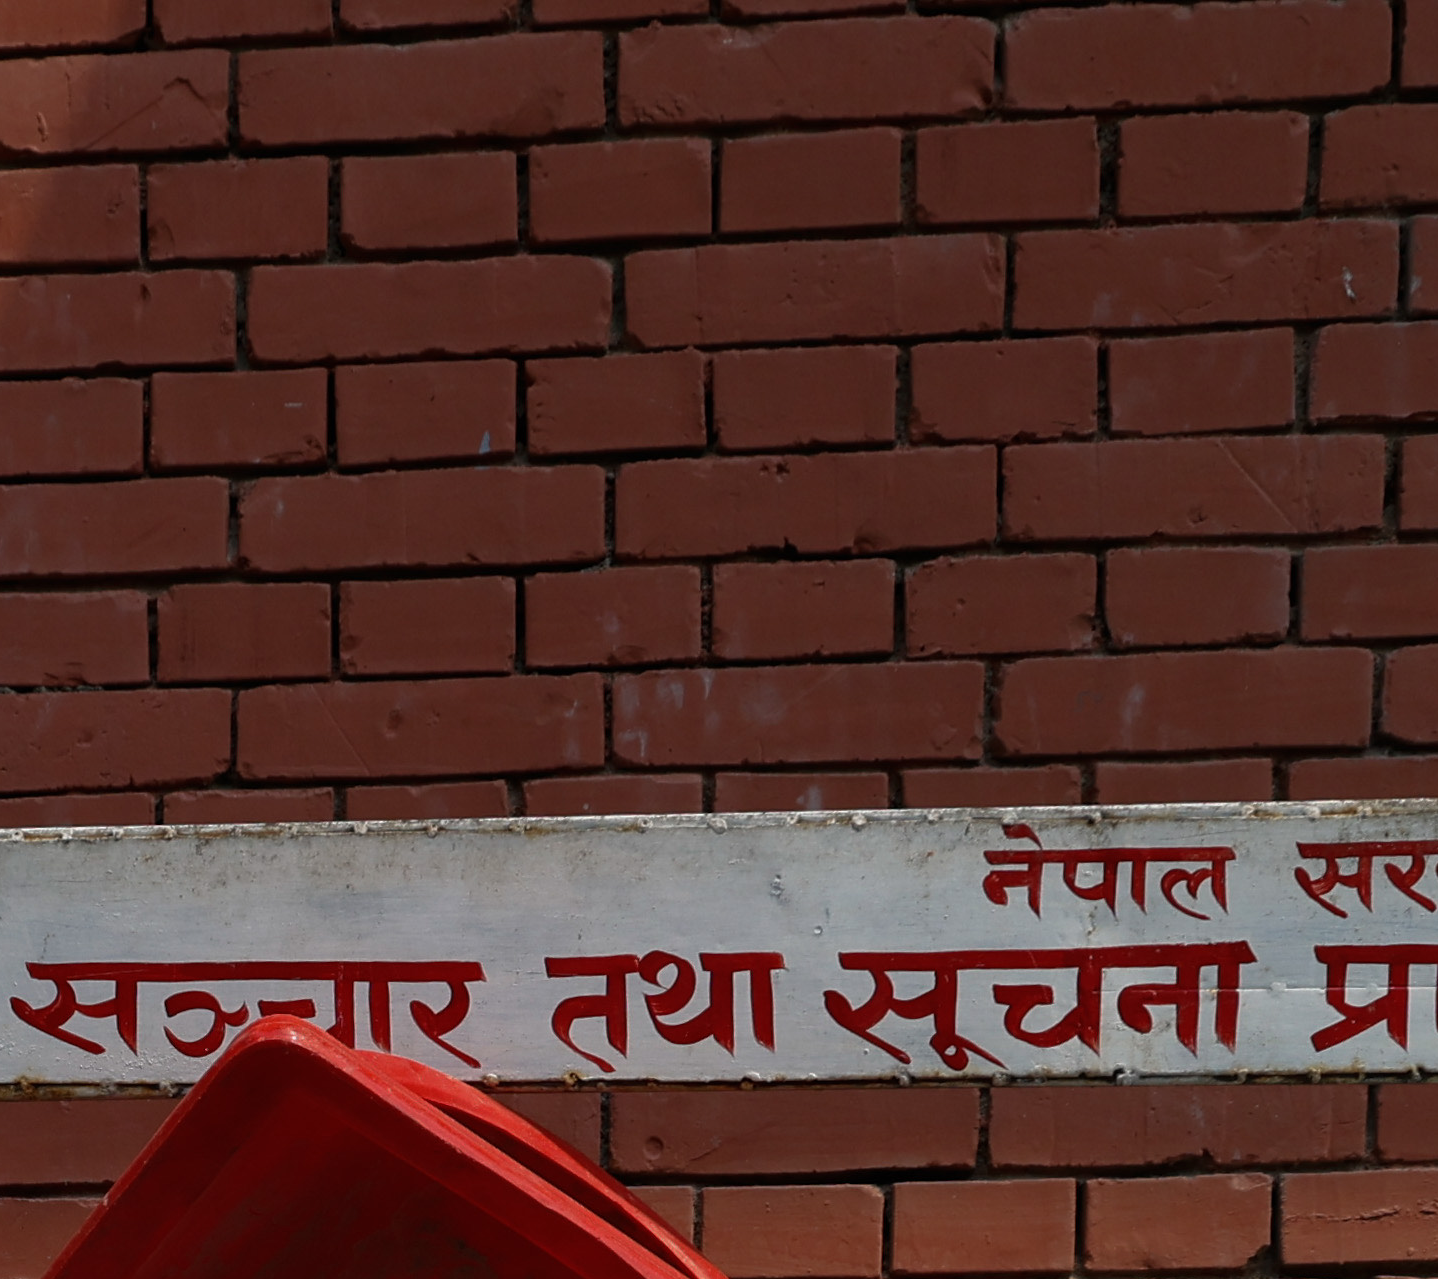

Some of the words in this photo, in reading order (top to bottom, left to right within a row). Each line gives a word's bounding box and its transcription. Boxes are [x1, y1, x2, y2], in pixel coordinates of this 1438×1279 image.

[983, 823, 1236, 920] नेपाल
[546, 951, 785, 1072] तथा
[824, 941, 1256, 1071] सूचना
